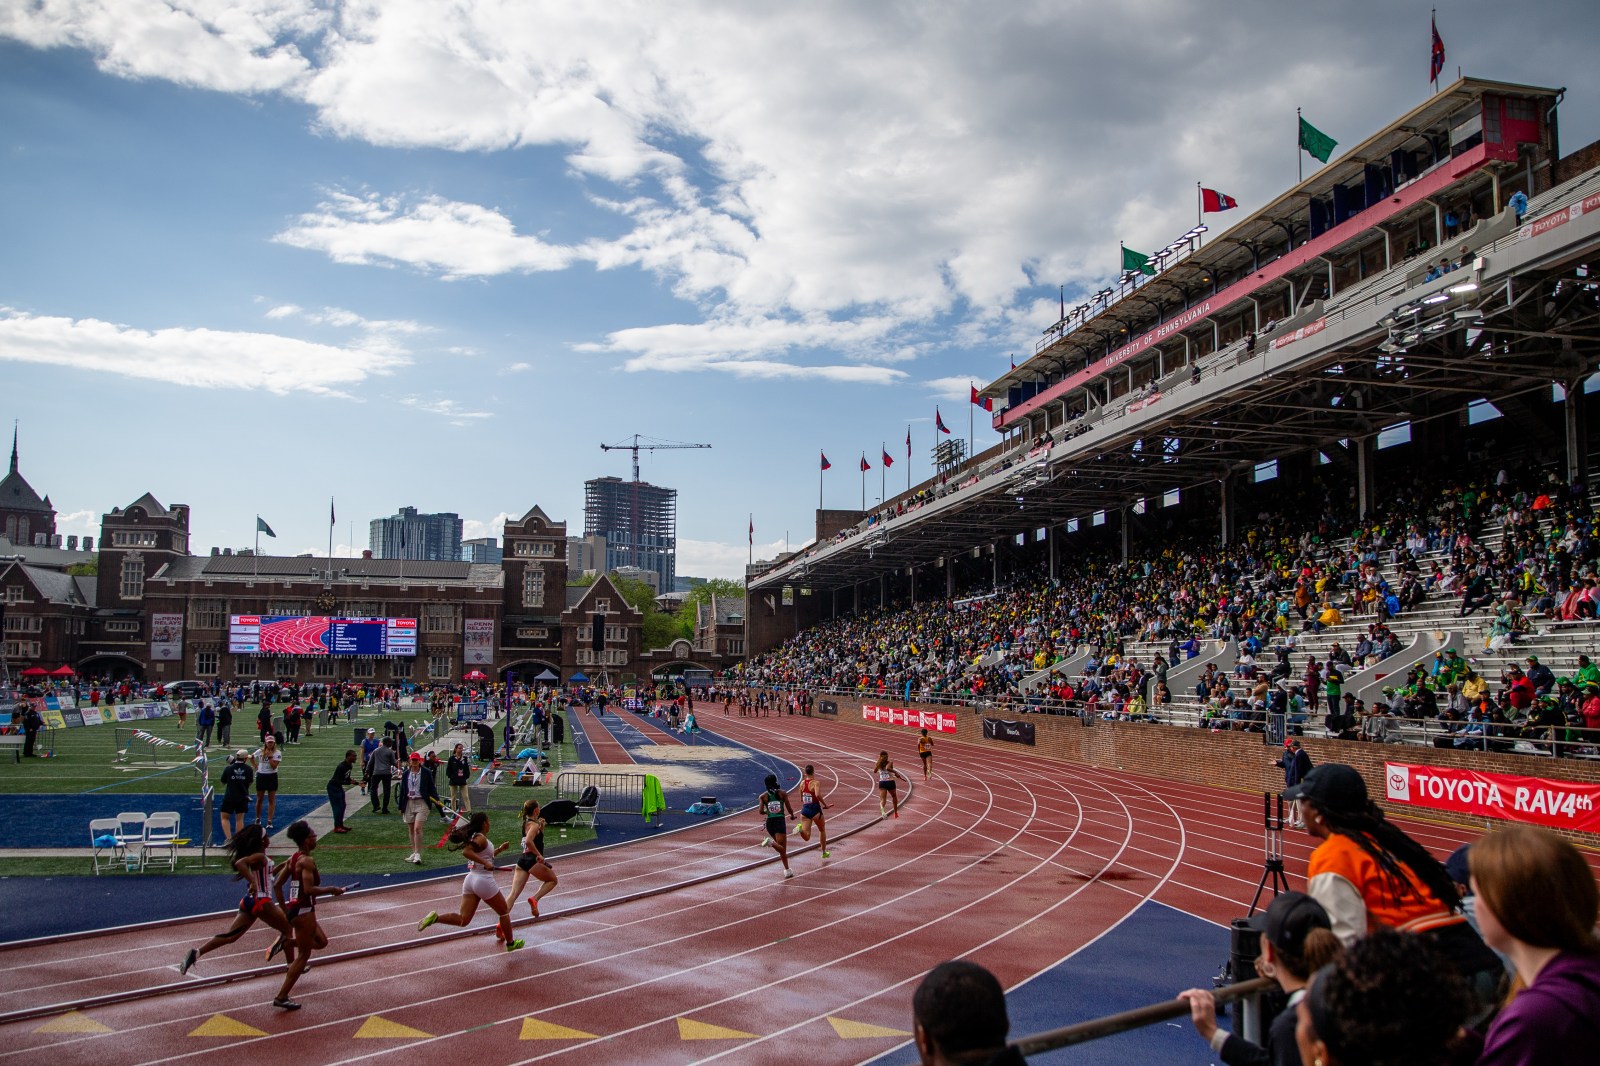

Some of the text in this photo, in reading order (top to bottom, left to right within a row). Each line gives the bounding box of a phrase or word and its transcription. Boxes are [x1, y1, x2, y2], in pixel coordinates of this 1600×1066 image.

[1535, 213, 1567, 232] TOYOTA
[1105, 302, 1210, 367] UNIVERSITY OF PENNSYLVANIA
[269, 608, 312, 616] FRANKLIN
[908, 715, 919, 723] TOYOTA
[943, 719, 956, 727] TOYOTA
[1416, 775, 1593, 818] TOYOTA RAV4th
